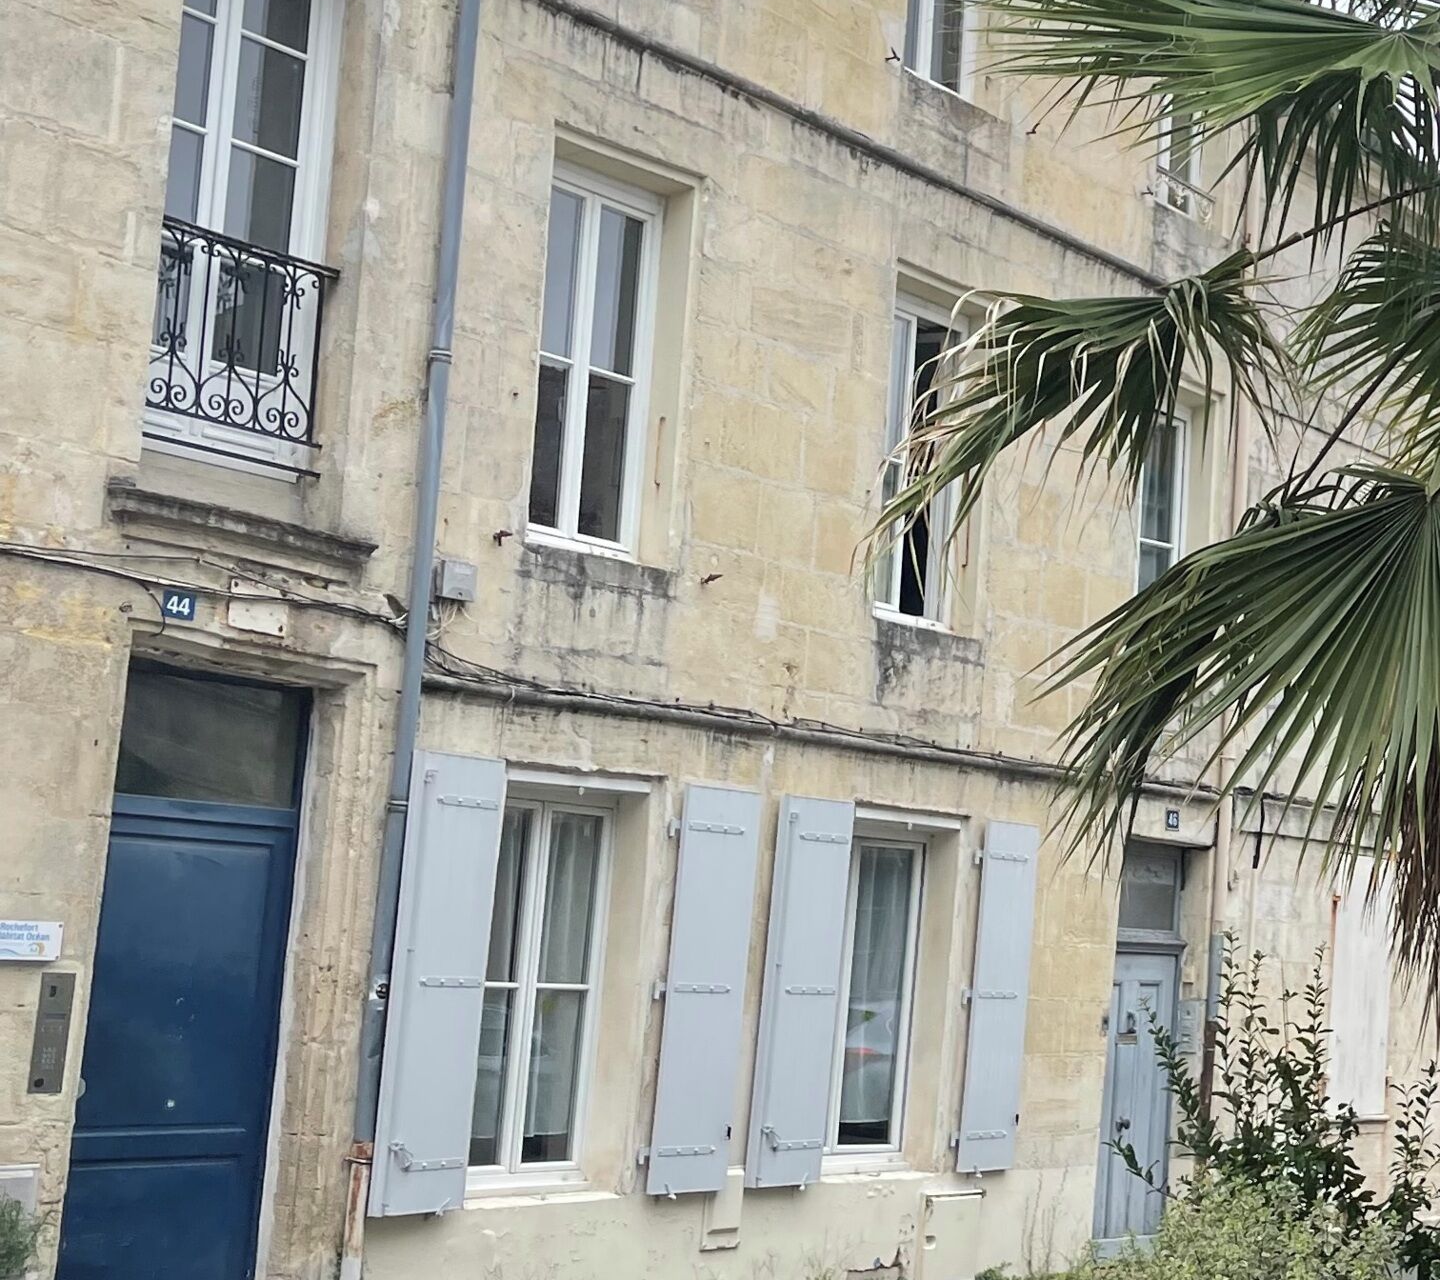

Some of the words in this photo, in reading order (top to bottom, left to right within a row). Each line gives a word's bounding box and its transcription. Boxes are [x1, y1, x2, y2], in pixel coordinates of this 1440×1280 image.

[166, 595, 191, 616] 44
[1168, 812, 1178, 827] 46
[0, 922, 38, 932] Rochefort
